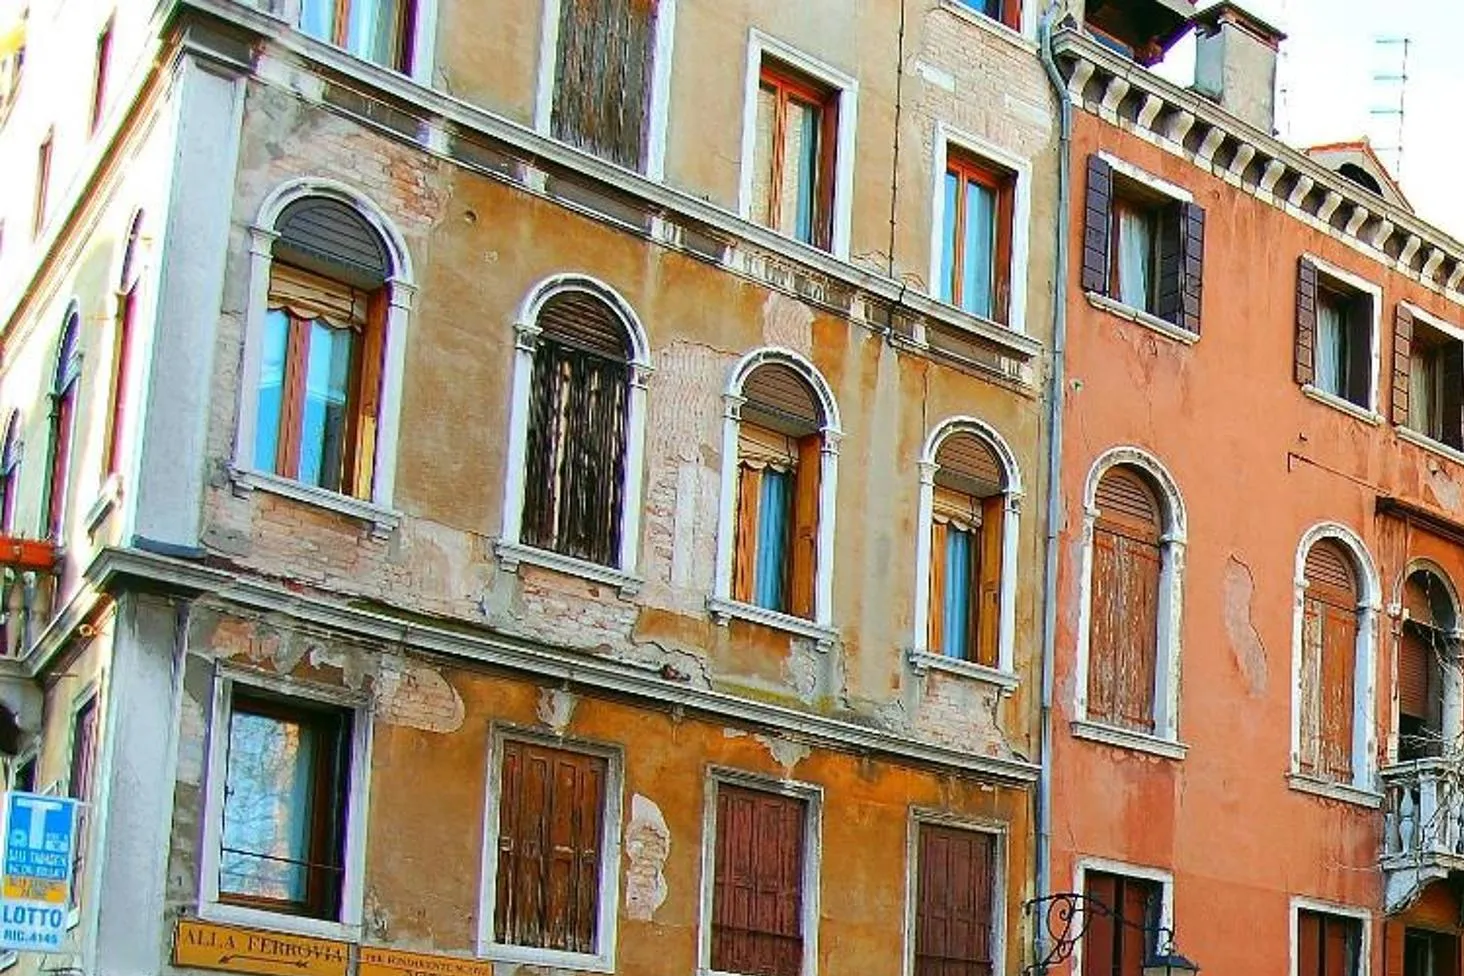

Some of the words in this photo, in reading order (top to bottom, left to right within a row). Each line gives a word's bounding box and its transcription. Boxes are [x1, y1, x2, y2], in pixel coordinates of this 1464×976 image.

[3, 904, 62, 928] LOTTO
[185, 929, 236, 949] ALLA
[249, 936, 343, 962] FERROVIA
